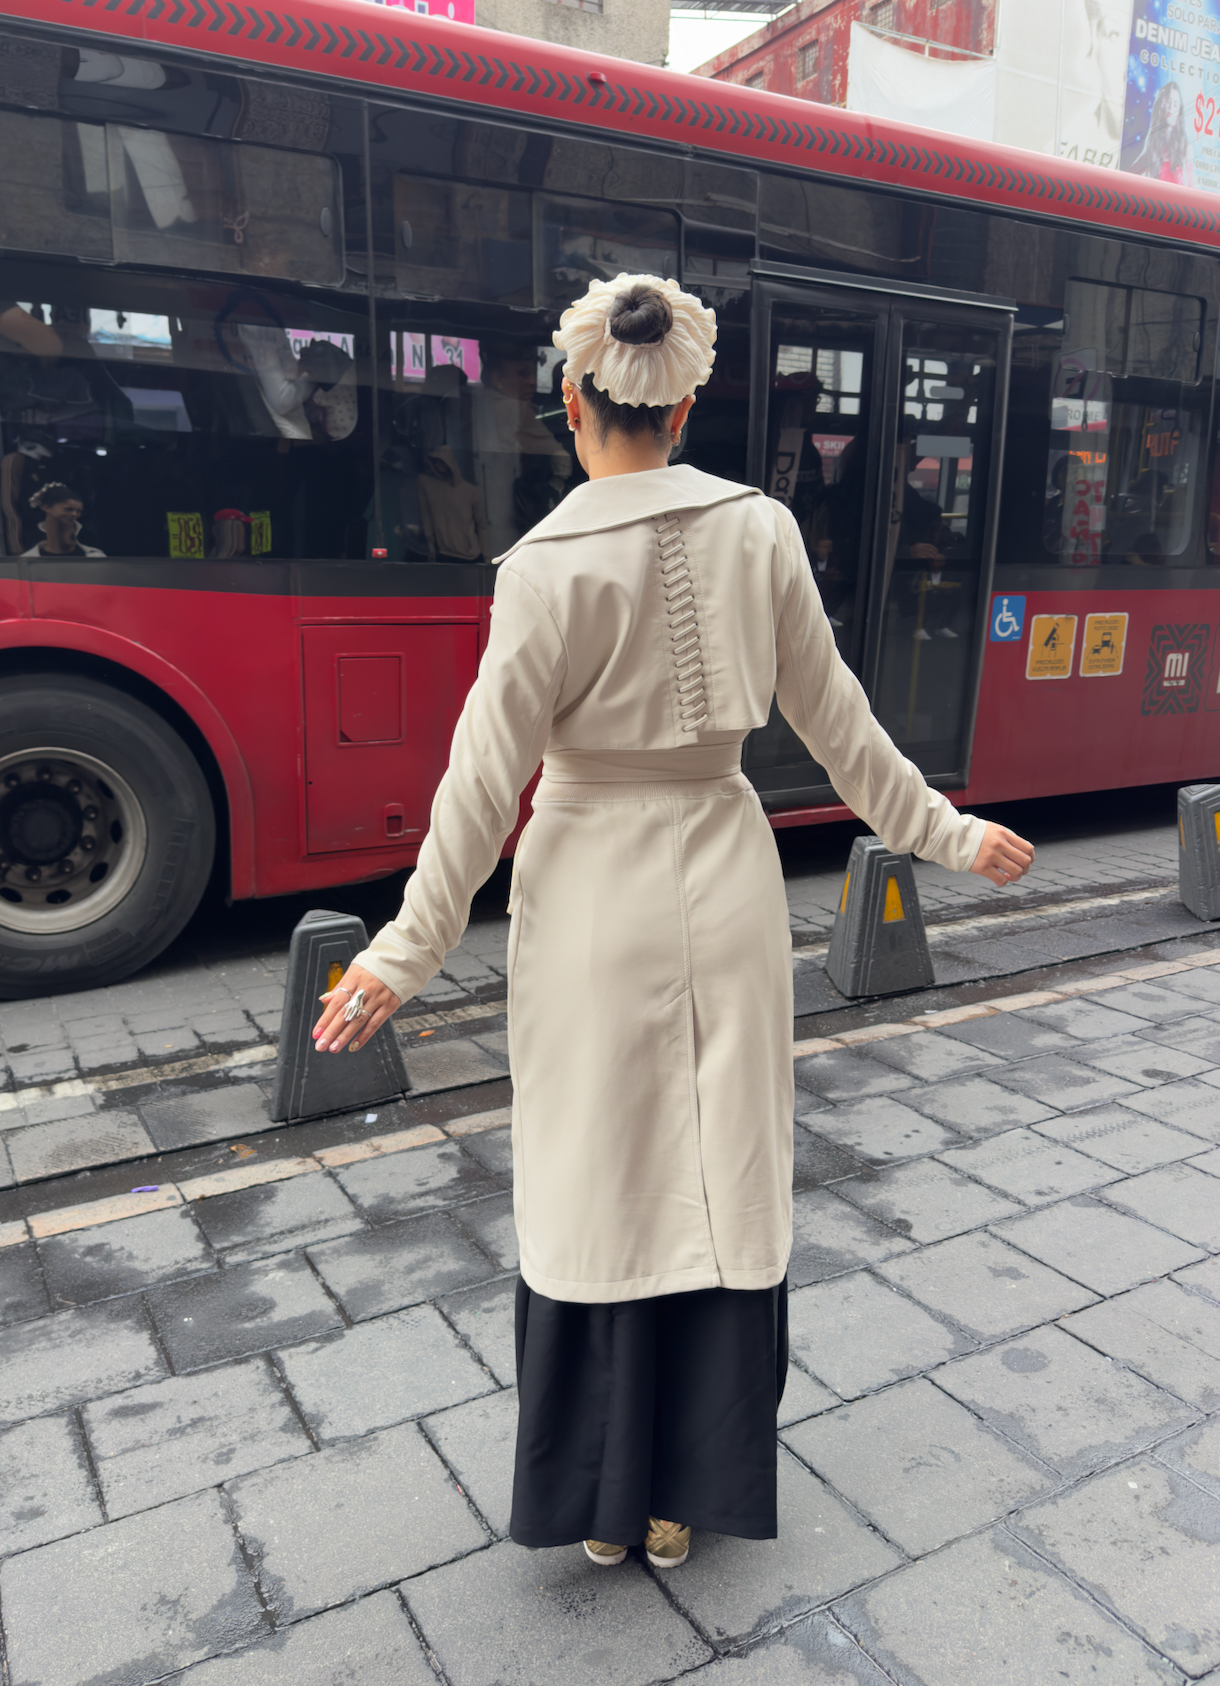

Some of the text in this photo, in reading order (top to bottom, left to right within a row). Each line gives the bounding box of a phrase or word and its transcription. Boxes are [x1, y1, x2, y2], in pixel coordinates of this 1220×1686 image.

[1167, 4, 1195, 25] SOLO
[1135, 18, 1188, 53] DENIM
[1140, 49, 1220, 84] COLLECTIO
